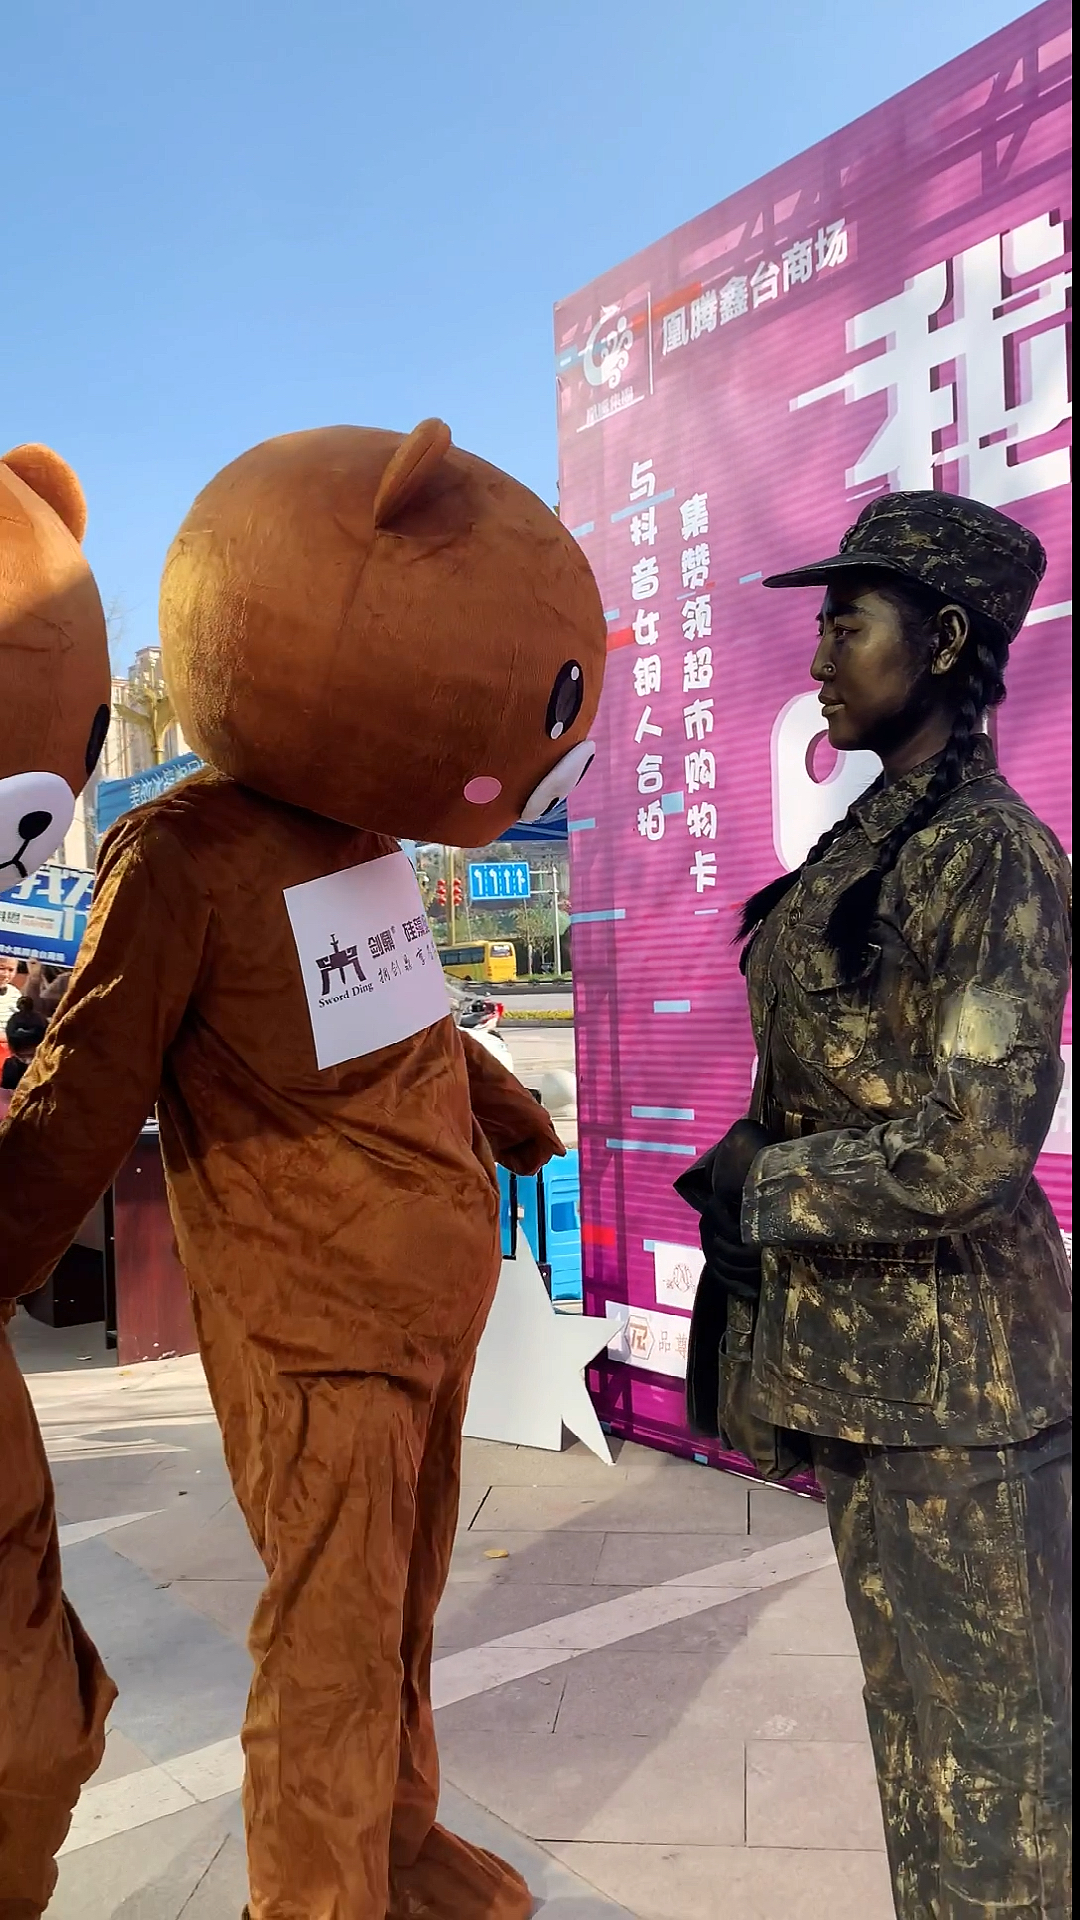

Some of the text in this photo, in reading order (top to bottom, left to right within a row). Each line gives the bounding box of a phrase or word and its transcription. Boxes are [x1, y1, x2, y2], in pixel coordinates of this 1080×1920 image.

[662, 217, 849, 356] 凰腾鑫台商场
[630, 457, 666, 842] 与抖音女铜人合拍
[680, 492, 718, 893] 集赞领超市购物卡
[318, 982, 374, 1008] Sword Ding
